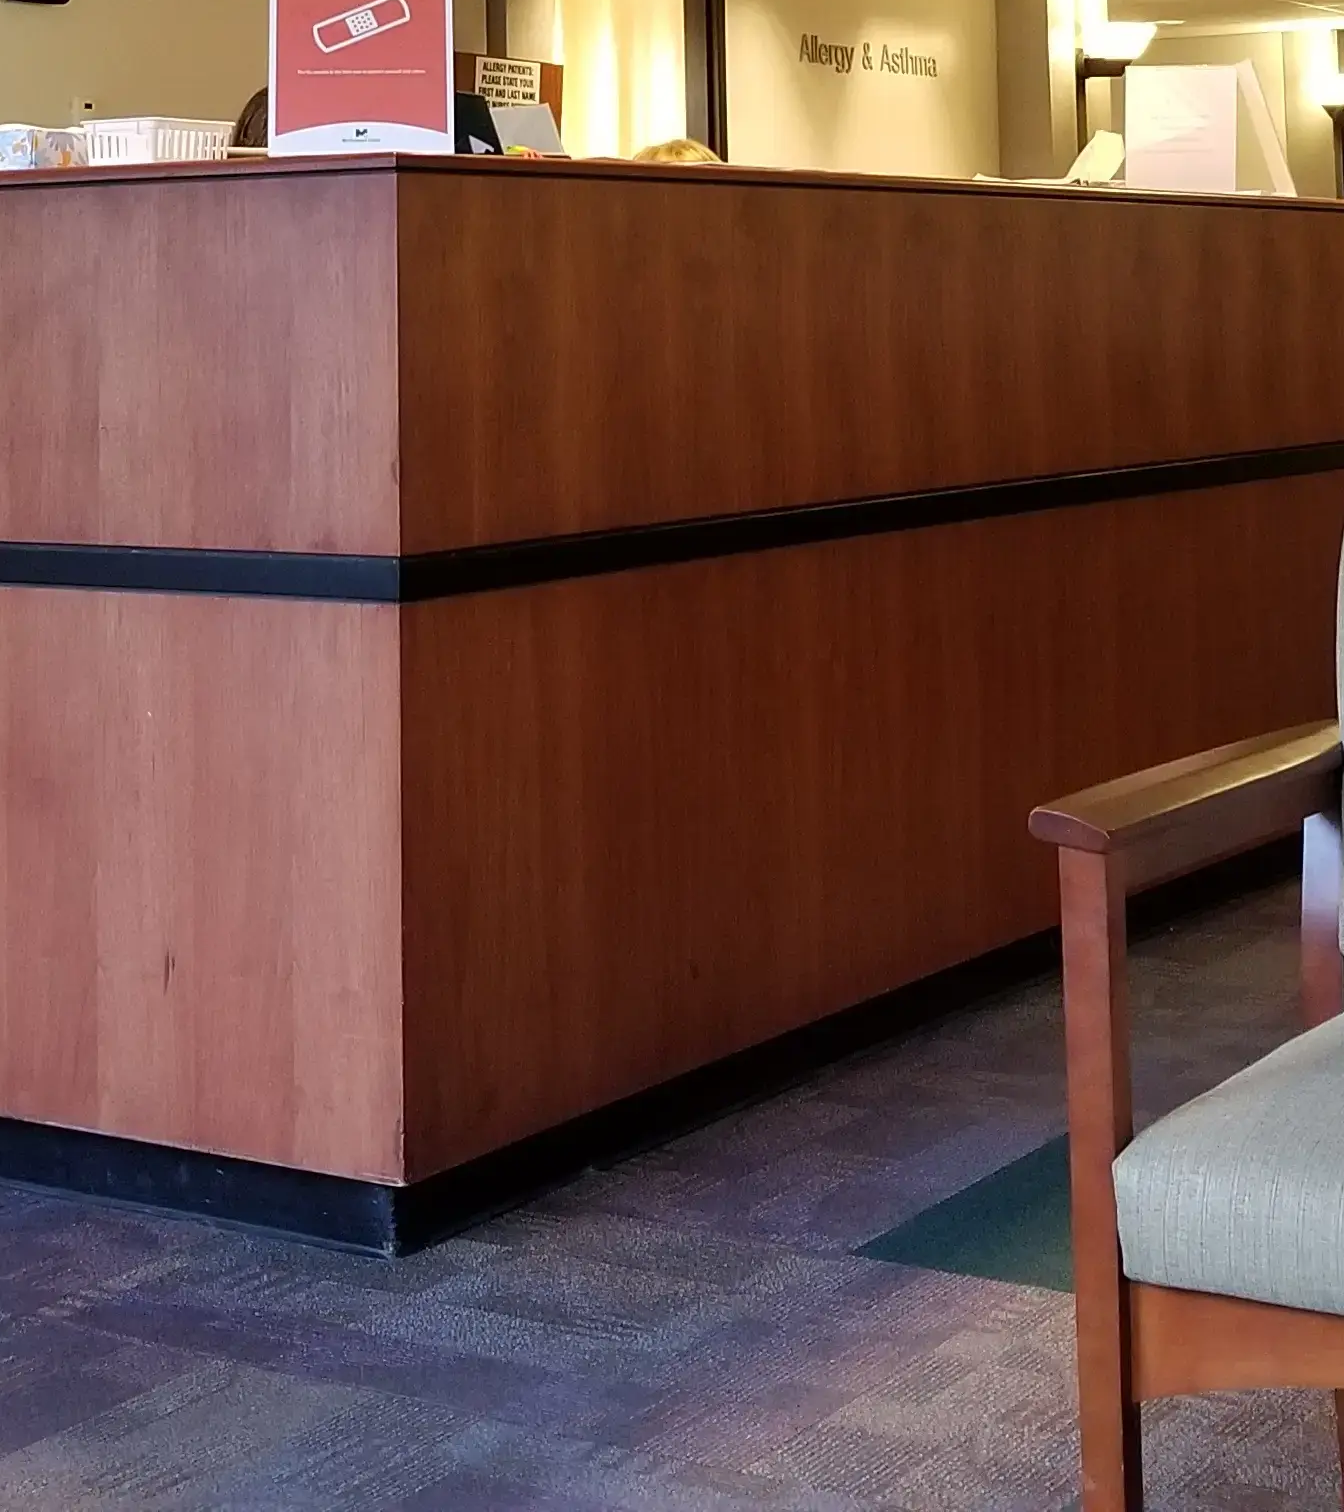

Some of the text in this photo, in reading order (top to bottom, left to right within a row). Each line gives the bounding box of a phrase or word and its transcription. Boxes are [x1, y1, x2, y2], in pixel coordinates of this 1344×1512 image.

[799, 33, 938, 77] Allergy & Asthma
[483, 62, 507, 73] ALLERGY
[482, 74, 534, 89] PLEASE STATE YOUR
[479, 87, 536, 102] FIRST AND LAST NAME
